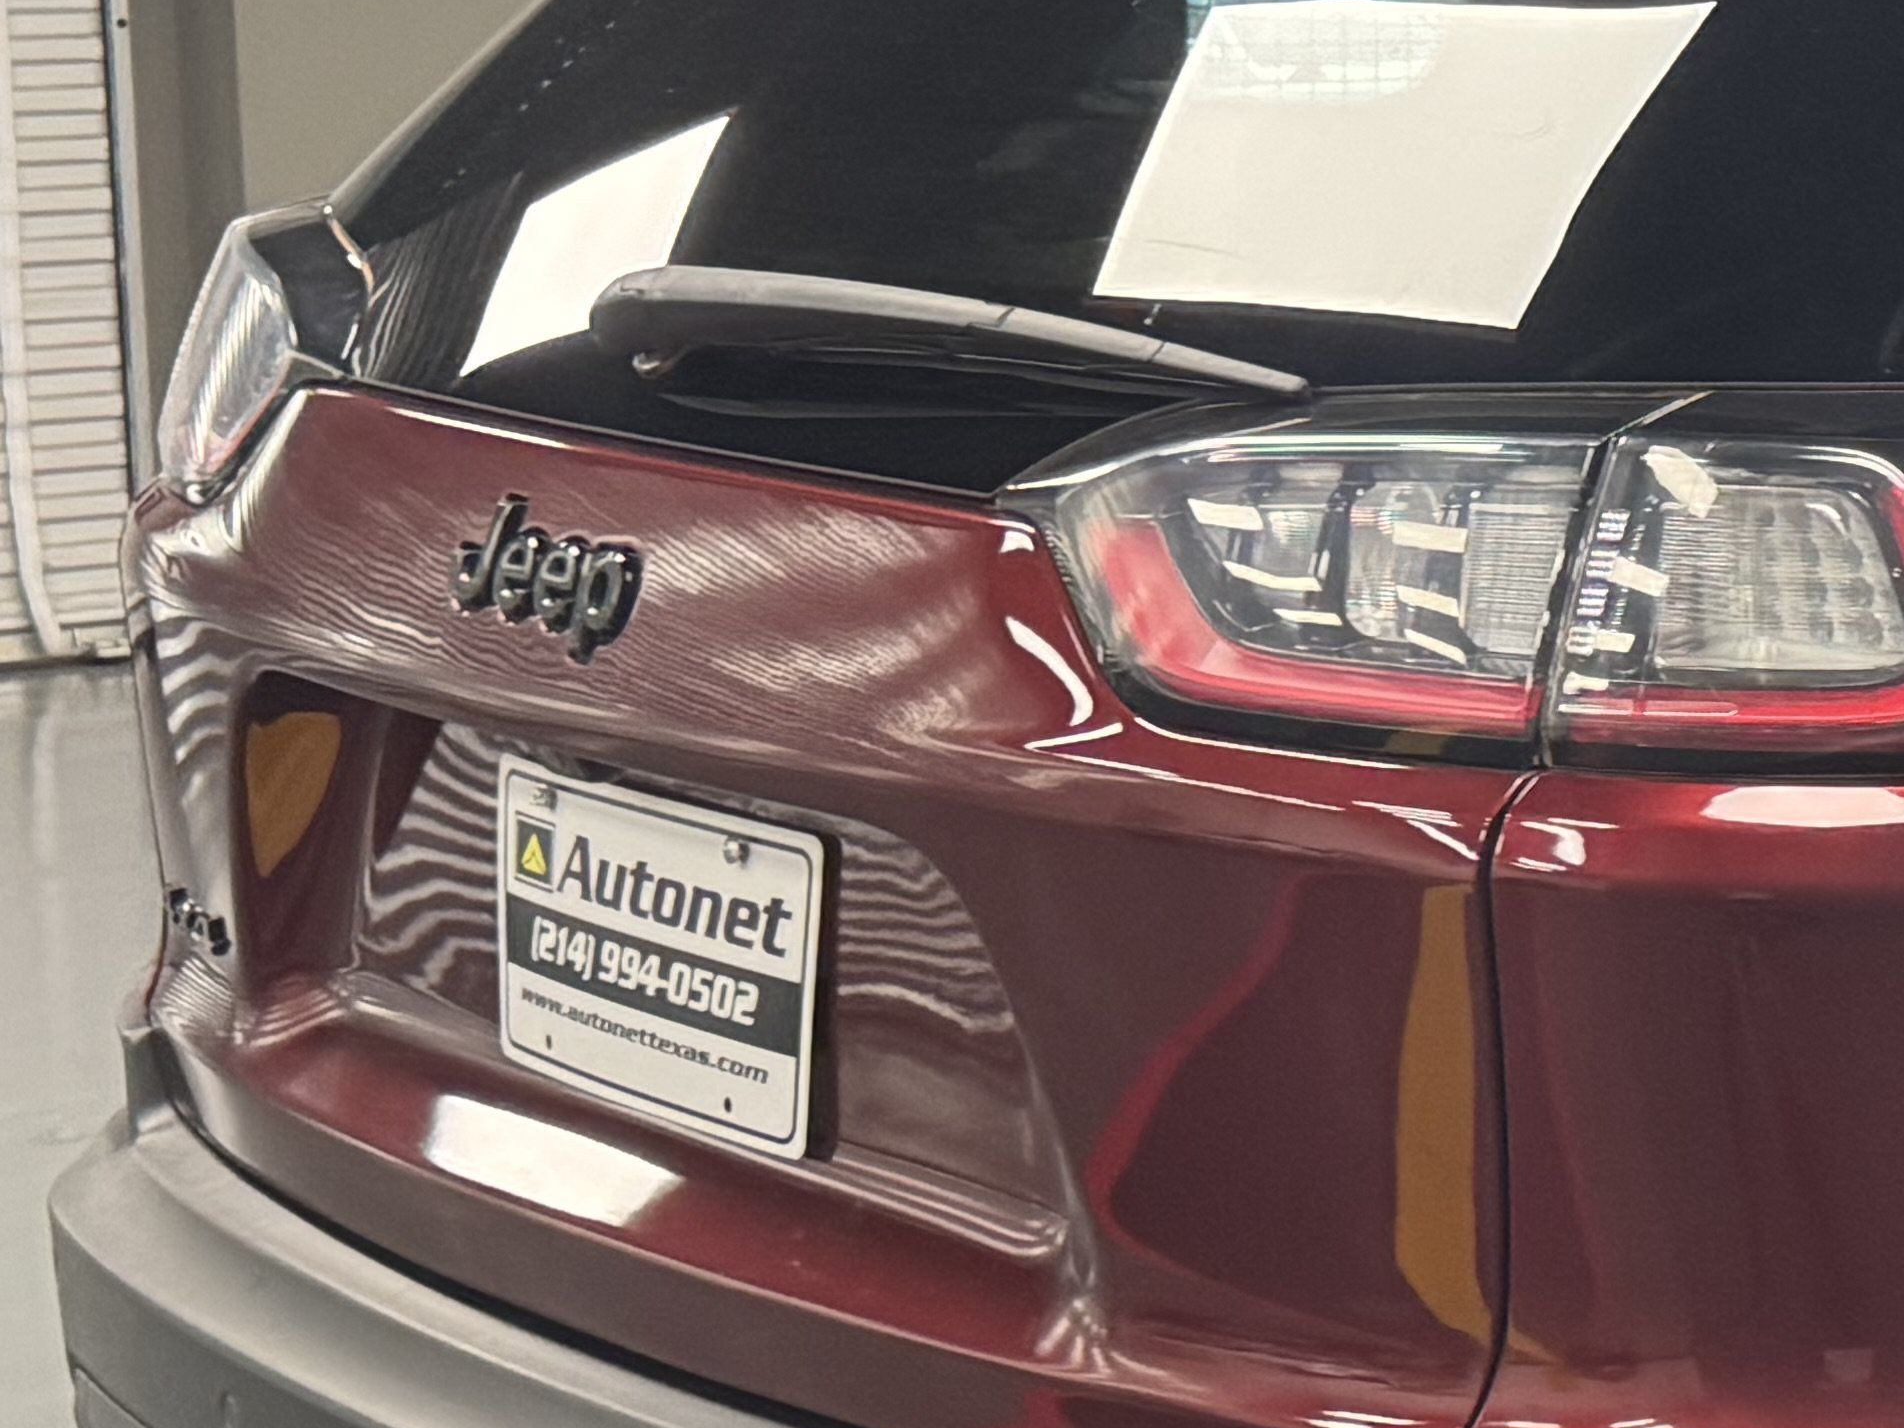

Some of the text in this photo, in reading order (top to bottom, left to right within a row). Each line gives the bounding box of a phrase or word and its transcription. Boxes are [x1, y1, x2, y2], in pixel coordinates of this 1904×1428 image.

[451, 492, 644, 665] Jeep
[557, 835, 792, 958] Autonet
[530, 915, 760, 1027] (214) 994-0502
[520, 985, 769, 1085] www.autonettexas.com
